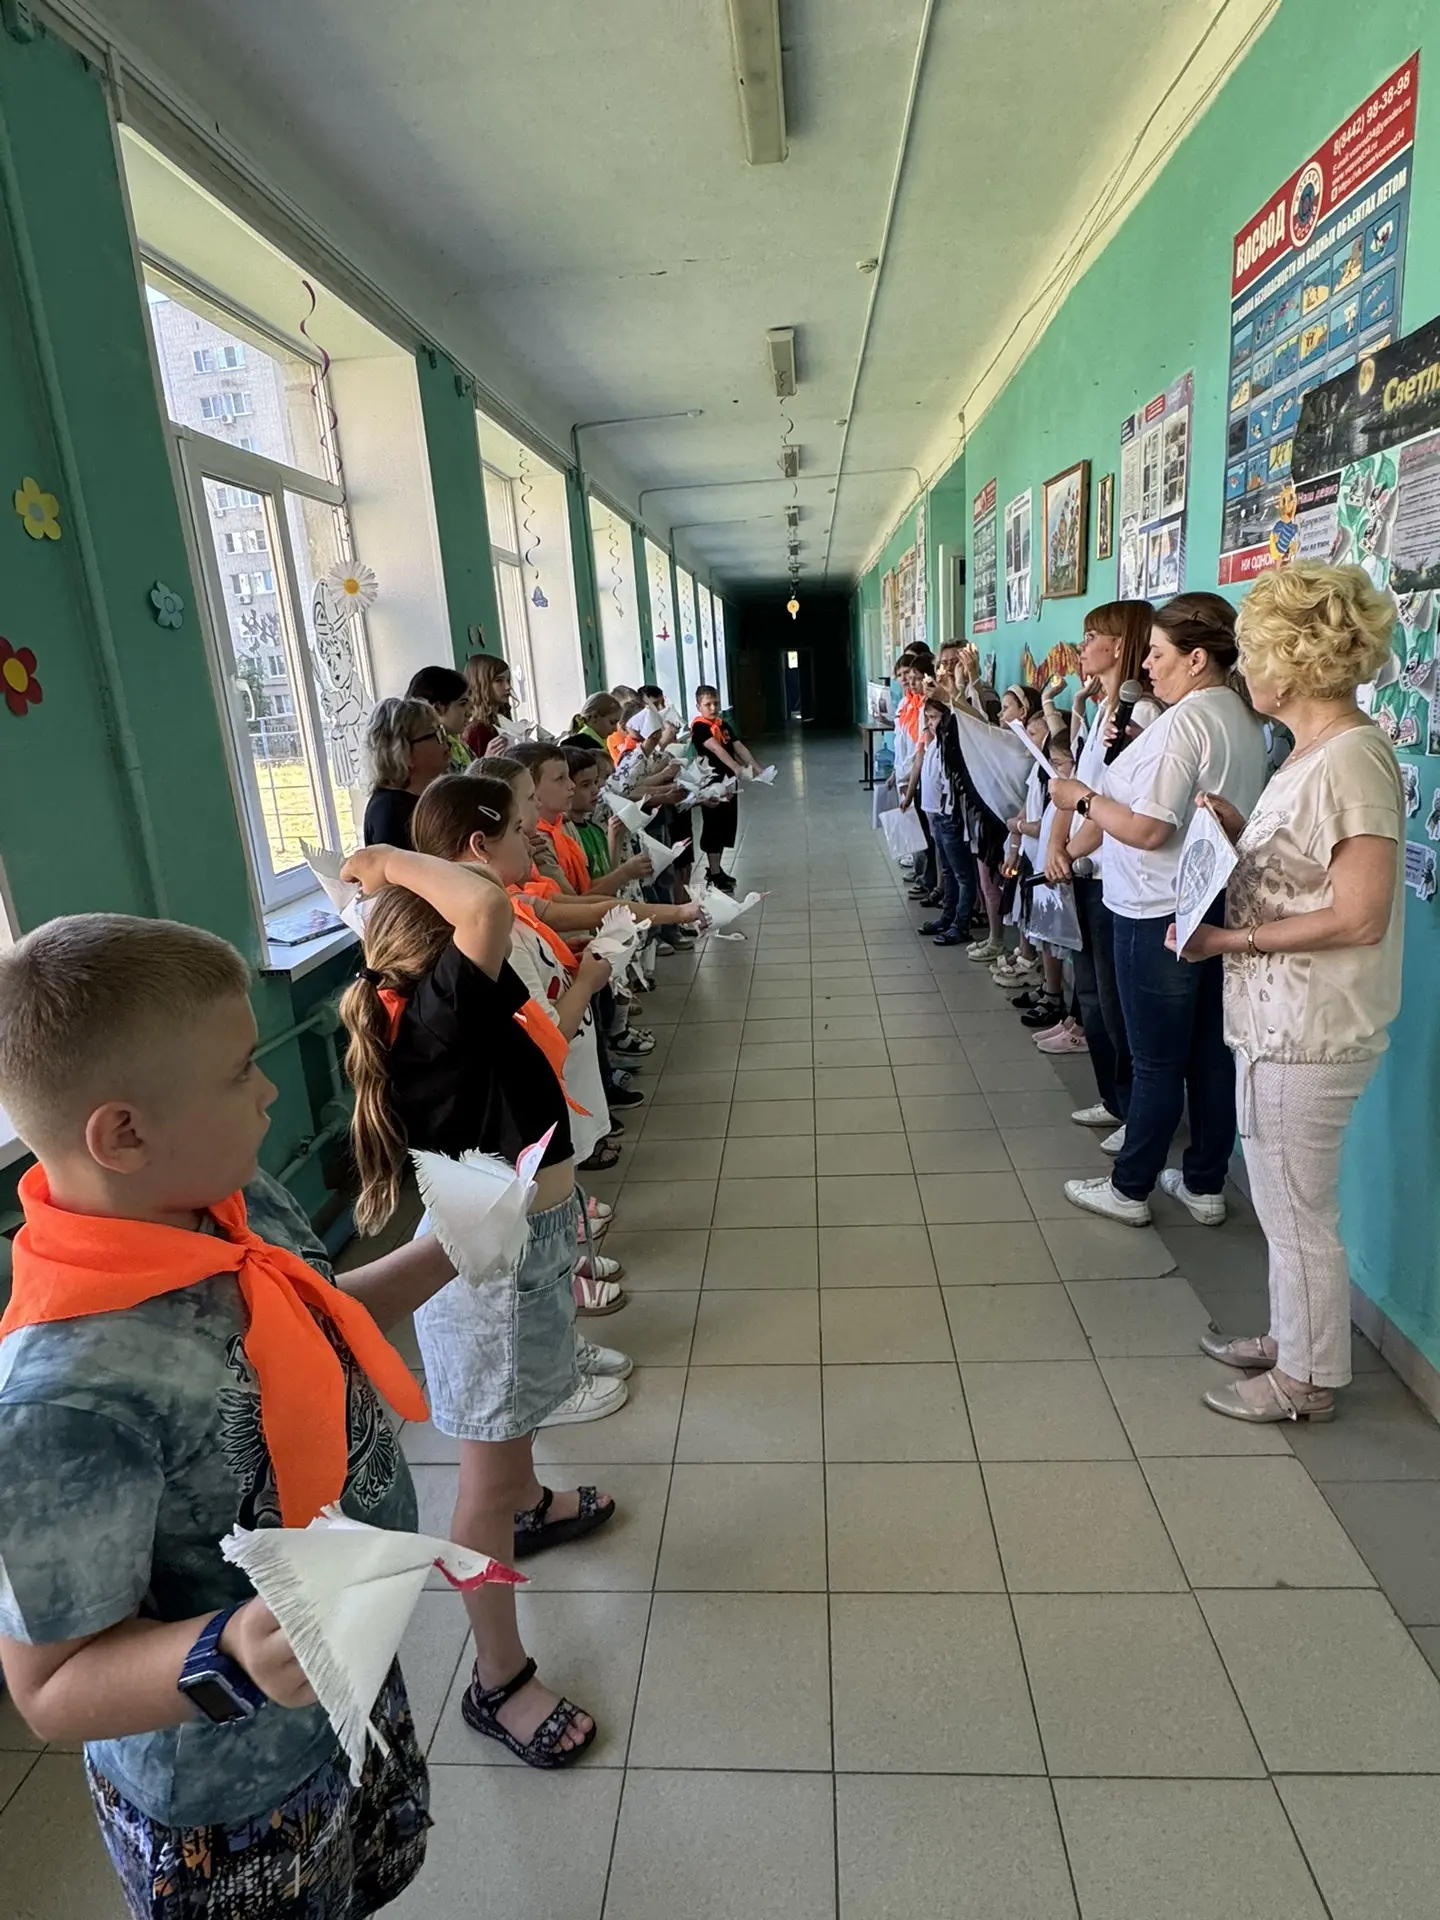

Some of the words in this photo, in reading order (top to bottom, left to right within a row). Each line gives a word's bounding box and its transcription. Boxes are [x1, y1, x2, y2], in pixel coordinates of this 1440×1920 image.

[1333, 113, 1365, 156] 8(8442)
[1366, 70, 1411, 124] 98-38-98
[1235, 199, 1286, 279] ВОСВОД
[1336, 192, 1377, 240] ОБЪЕКТАХ
[1376, 166, 1408, 208] ЛЕТОМ
[1383, 362, 1440, 413] Светл
[1241, 560, 1251, 572] НИ
